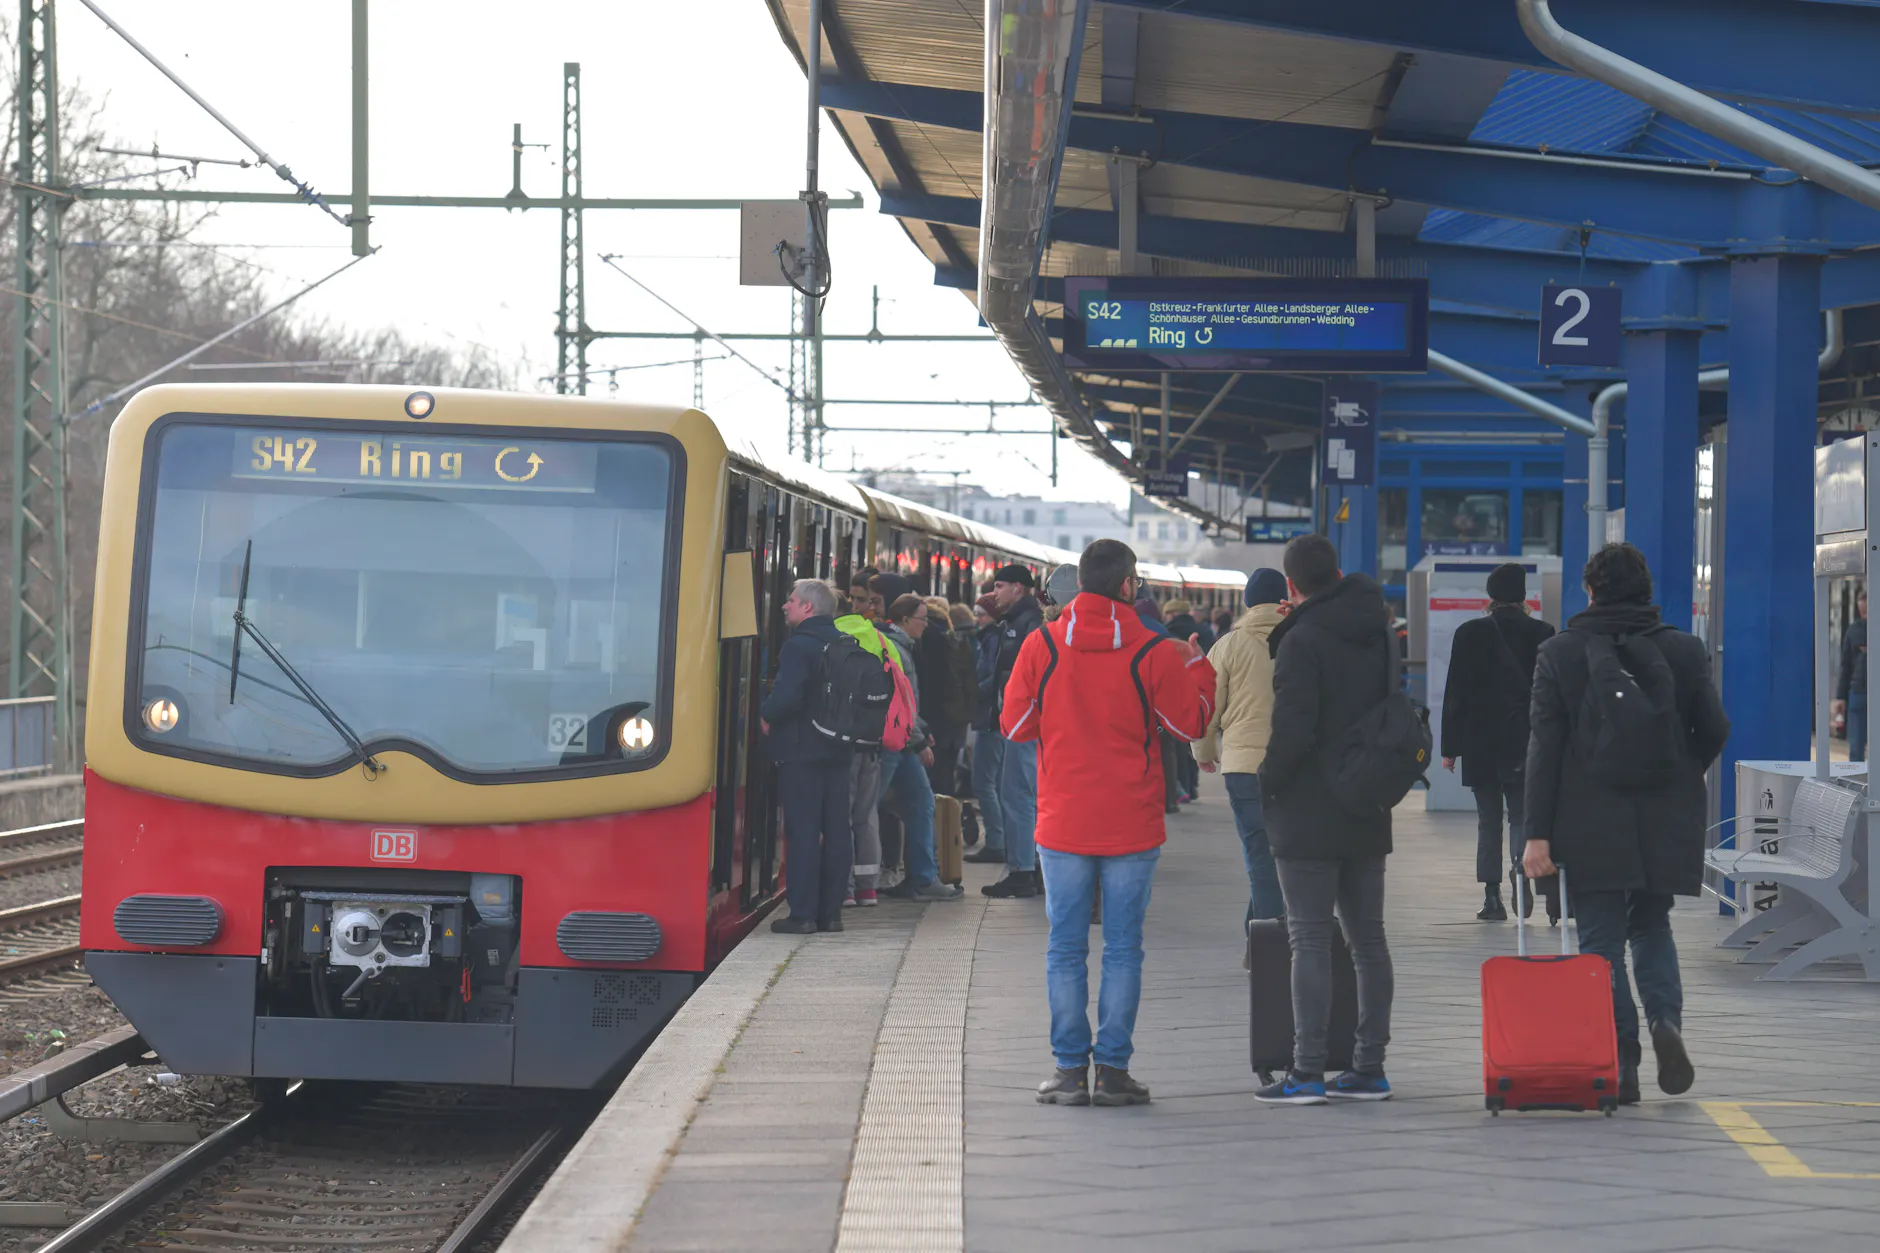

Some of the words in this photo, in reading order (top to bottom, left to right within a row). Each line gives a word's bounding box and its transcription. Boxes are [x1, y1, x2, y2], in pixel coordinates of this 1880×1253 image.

[1087, 302, 1122, 320] S42
[1149, 302, 1250, 313] Ostkreuz-Frankfurter
[1254, 303, 1340, 315] Allee-Landsberger
[1344, 304, 1375, 314] Allee-
[1149, 313, 1207, 323] Schönhauser
[1210, 314, 1355, 327] Allee-Gesundbrunnen-Wedding
[1551, 288, 1591, 347] 2
[1149, 326, 1186, 349] Ring
[251, 436, 317, 474] S42
[360, 440, 463, 480] Ring
[550, 716, 585, 747] 32
[376, 833, 412, 857] DB
[1753, 817, 1779, 913] Aball
